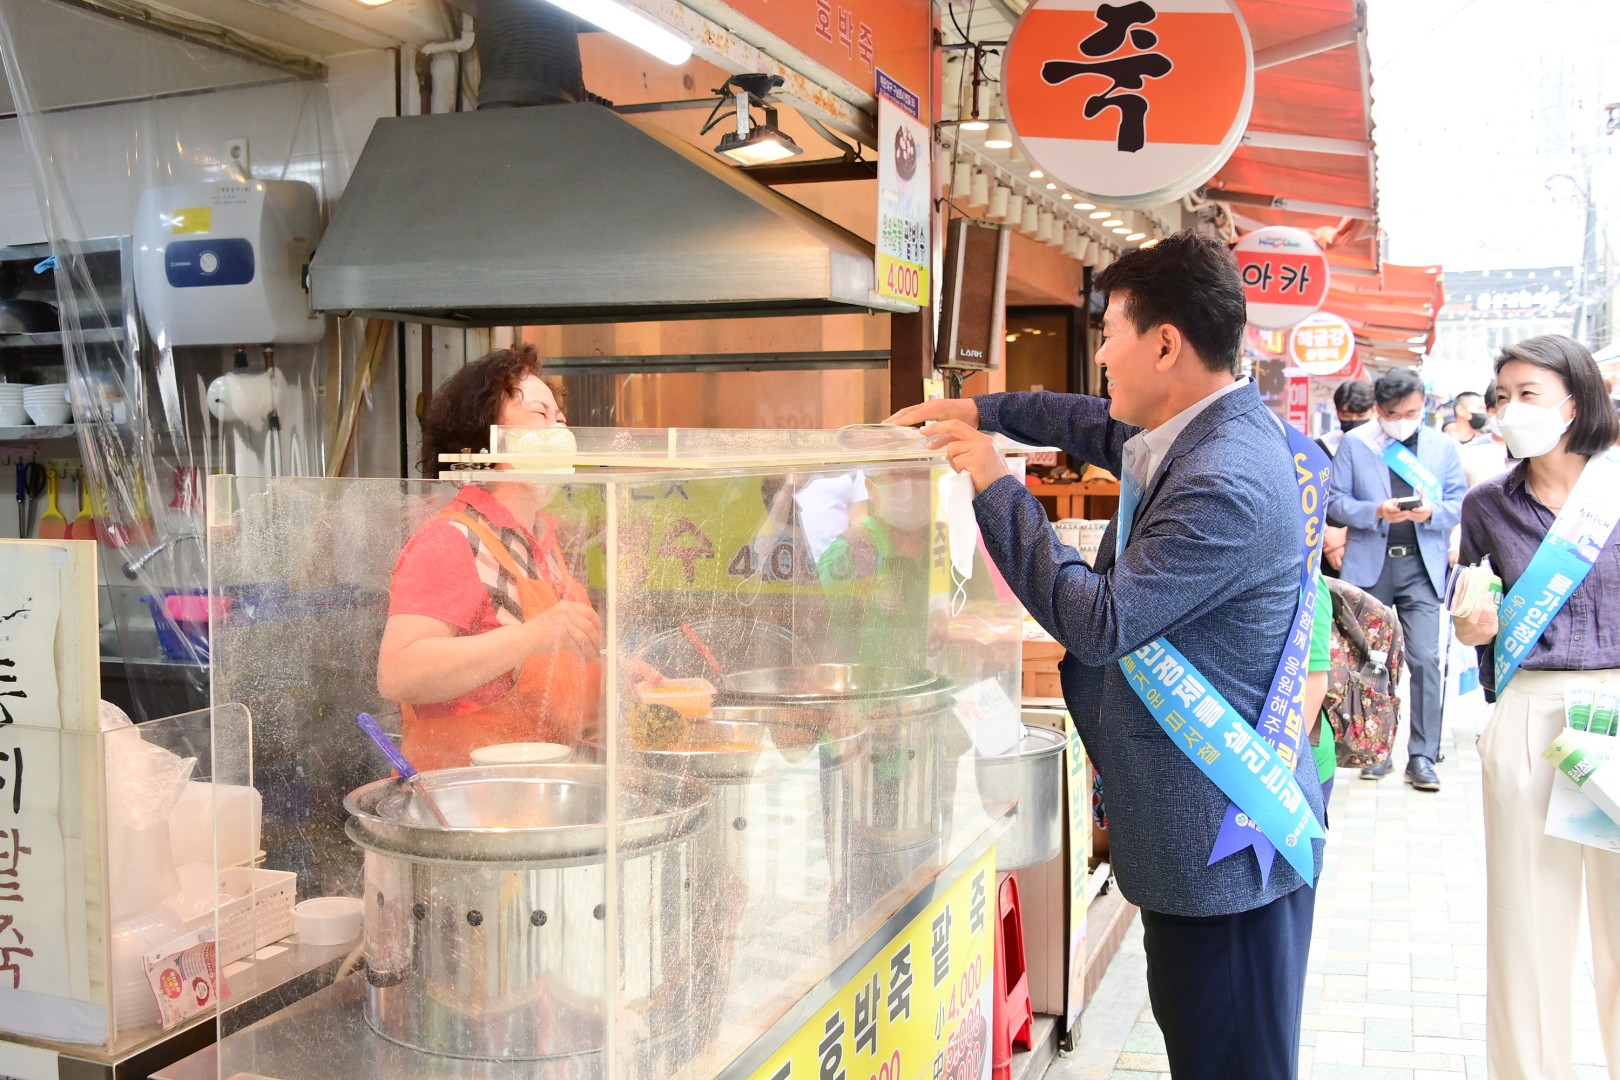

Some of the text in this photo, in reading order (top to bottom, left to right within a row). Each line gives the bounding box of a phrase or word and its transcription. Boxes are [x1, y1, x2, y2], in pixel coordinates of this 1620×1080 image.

[815, 0, 873, 73] 호박죽
[1041, 1, 1172, 153] 죽
[904, 219, 926, 262] 팥빙수
[887, 262, 919, 299] 4.000
[1242, 262, 1310, 293] 아카
[960, 348, 983, 359] LARK
[1296, 328, 1346, 348] 해금강
[1503, 572, 1575, 660] 물가안정이
[1121, 655, 1221, 766] 즐거운 피서철
[1135, 640, 1226, 729] 민경제를
[818, 941, 914, 1080] 호박죽
[947, 953, 982, 1021] 4.000
[945, 998, 982, 1073] 5.000
